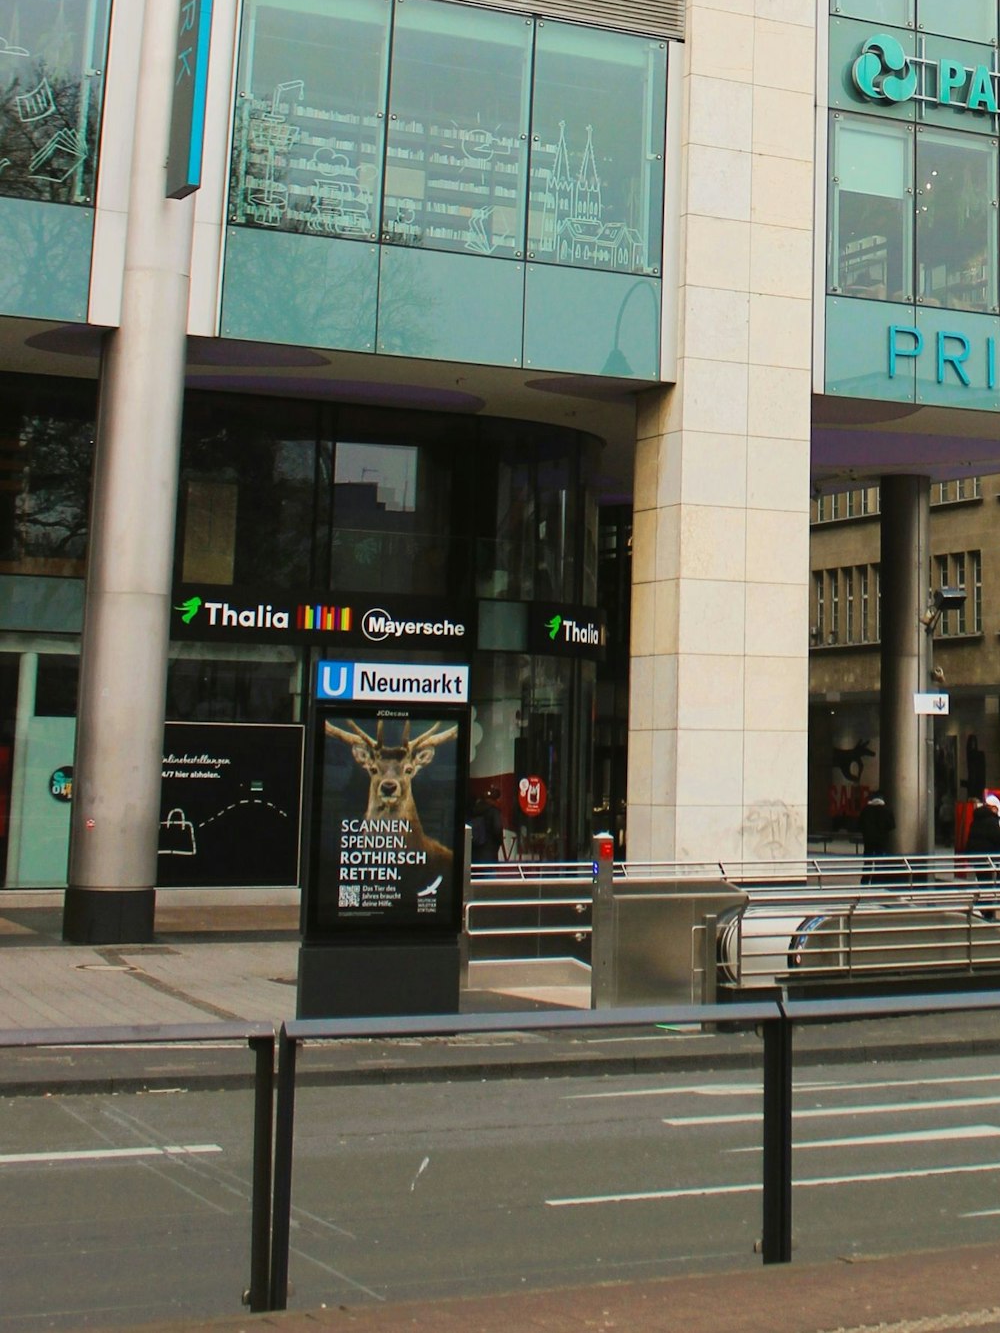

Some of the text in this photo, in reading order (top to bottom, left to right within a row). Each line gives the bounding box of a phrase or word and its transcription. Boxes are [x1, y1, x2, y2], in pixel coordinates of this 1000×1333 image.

[204, 602, 289, 629] Thalia
[368, 617, 465, 637] Mayersche
[562, 620, 599, 645] Thalia
[322, 666, 462, 696] U Neumarkt
[162, 754, 231, 768] nlinebestellungen
[341, 819, 413, 833] SCANNEN.
[341, 835, 407, 849] SPENDEN.
[340, 851, 427, 865] ROTHIRSCH
[339, 867, 402, 880] RETTEN.
